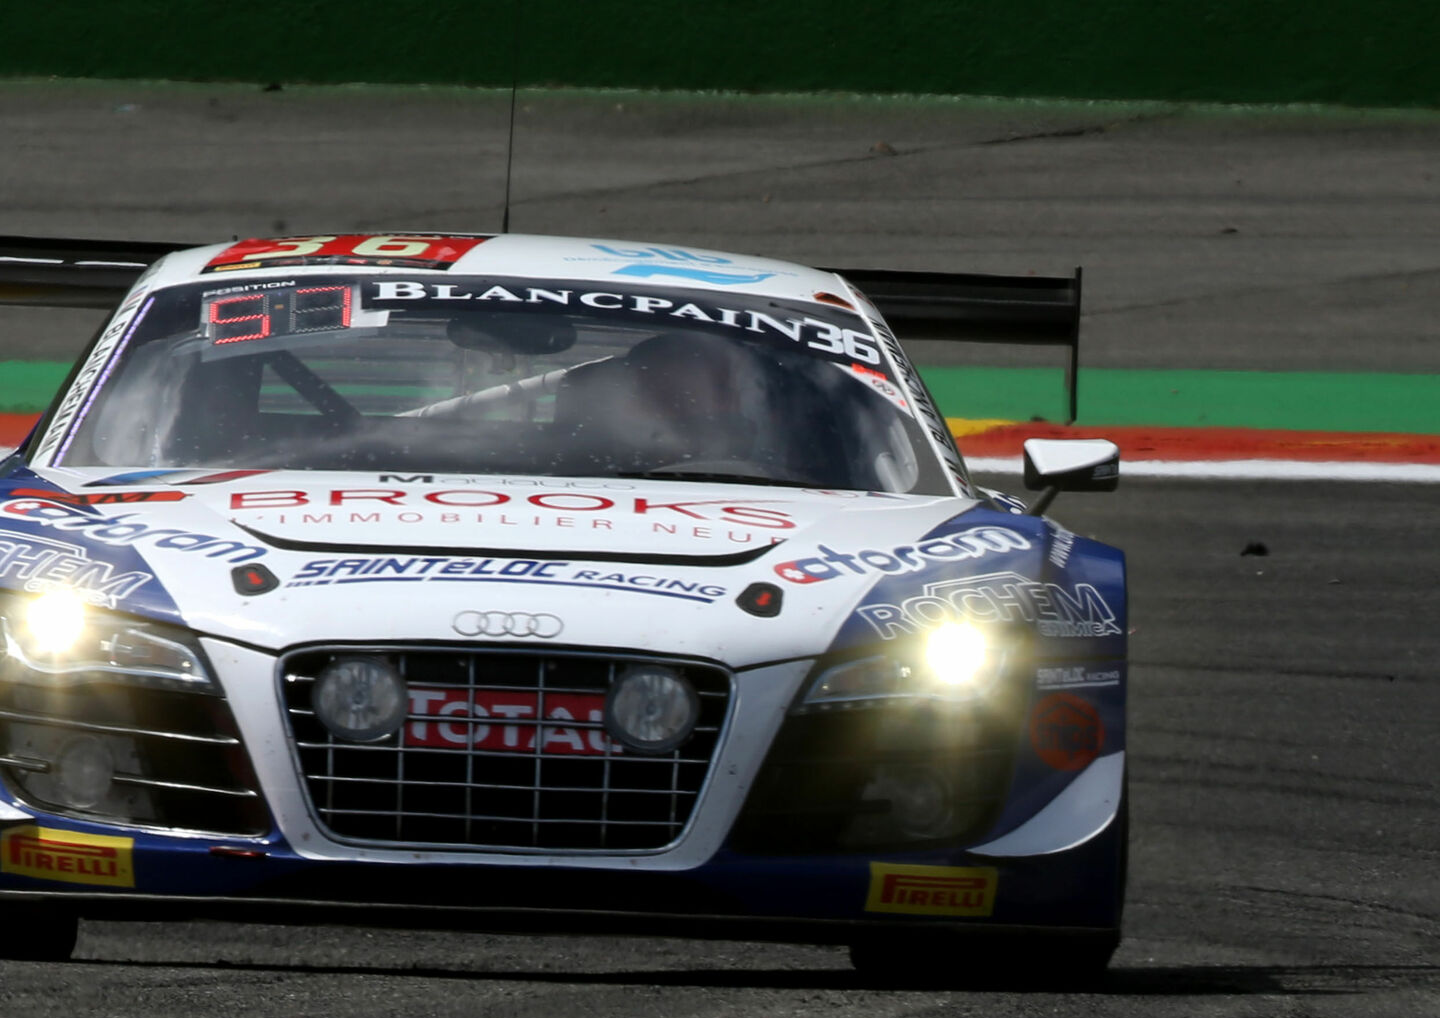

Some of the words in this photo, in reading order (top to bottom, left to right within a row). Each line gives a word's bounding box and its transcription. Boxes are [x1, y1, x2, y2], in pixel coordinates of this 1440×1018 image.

[242, 236, 441, 260] 36
[202, 280, 296, 298] POSITION
[372, 281, 807, 342] BLANCPAIN
[808, 317, 880, 366] 36
[229, 489, 797, 530] BROOKS
[232, 512, 614, 531] 'IMMOBILIER
[573, 568, 726, 598] RACING
[857, 583, 1116, 640] ROCHEM
[408, 689, 624, 753] TOTAL
[9, 833, 118, 878] PIRELLI
[880, 872, 988, 908] PIRELLI
